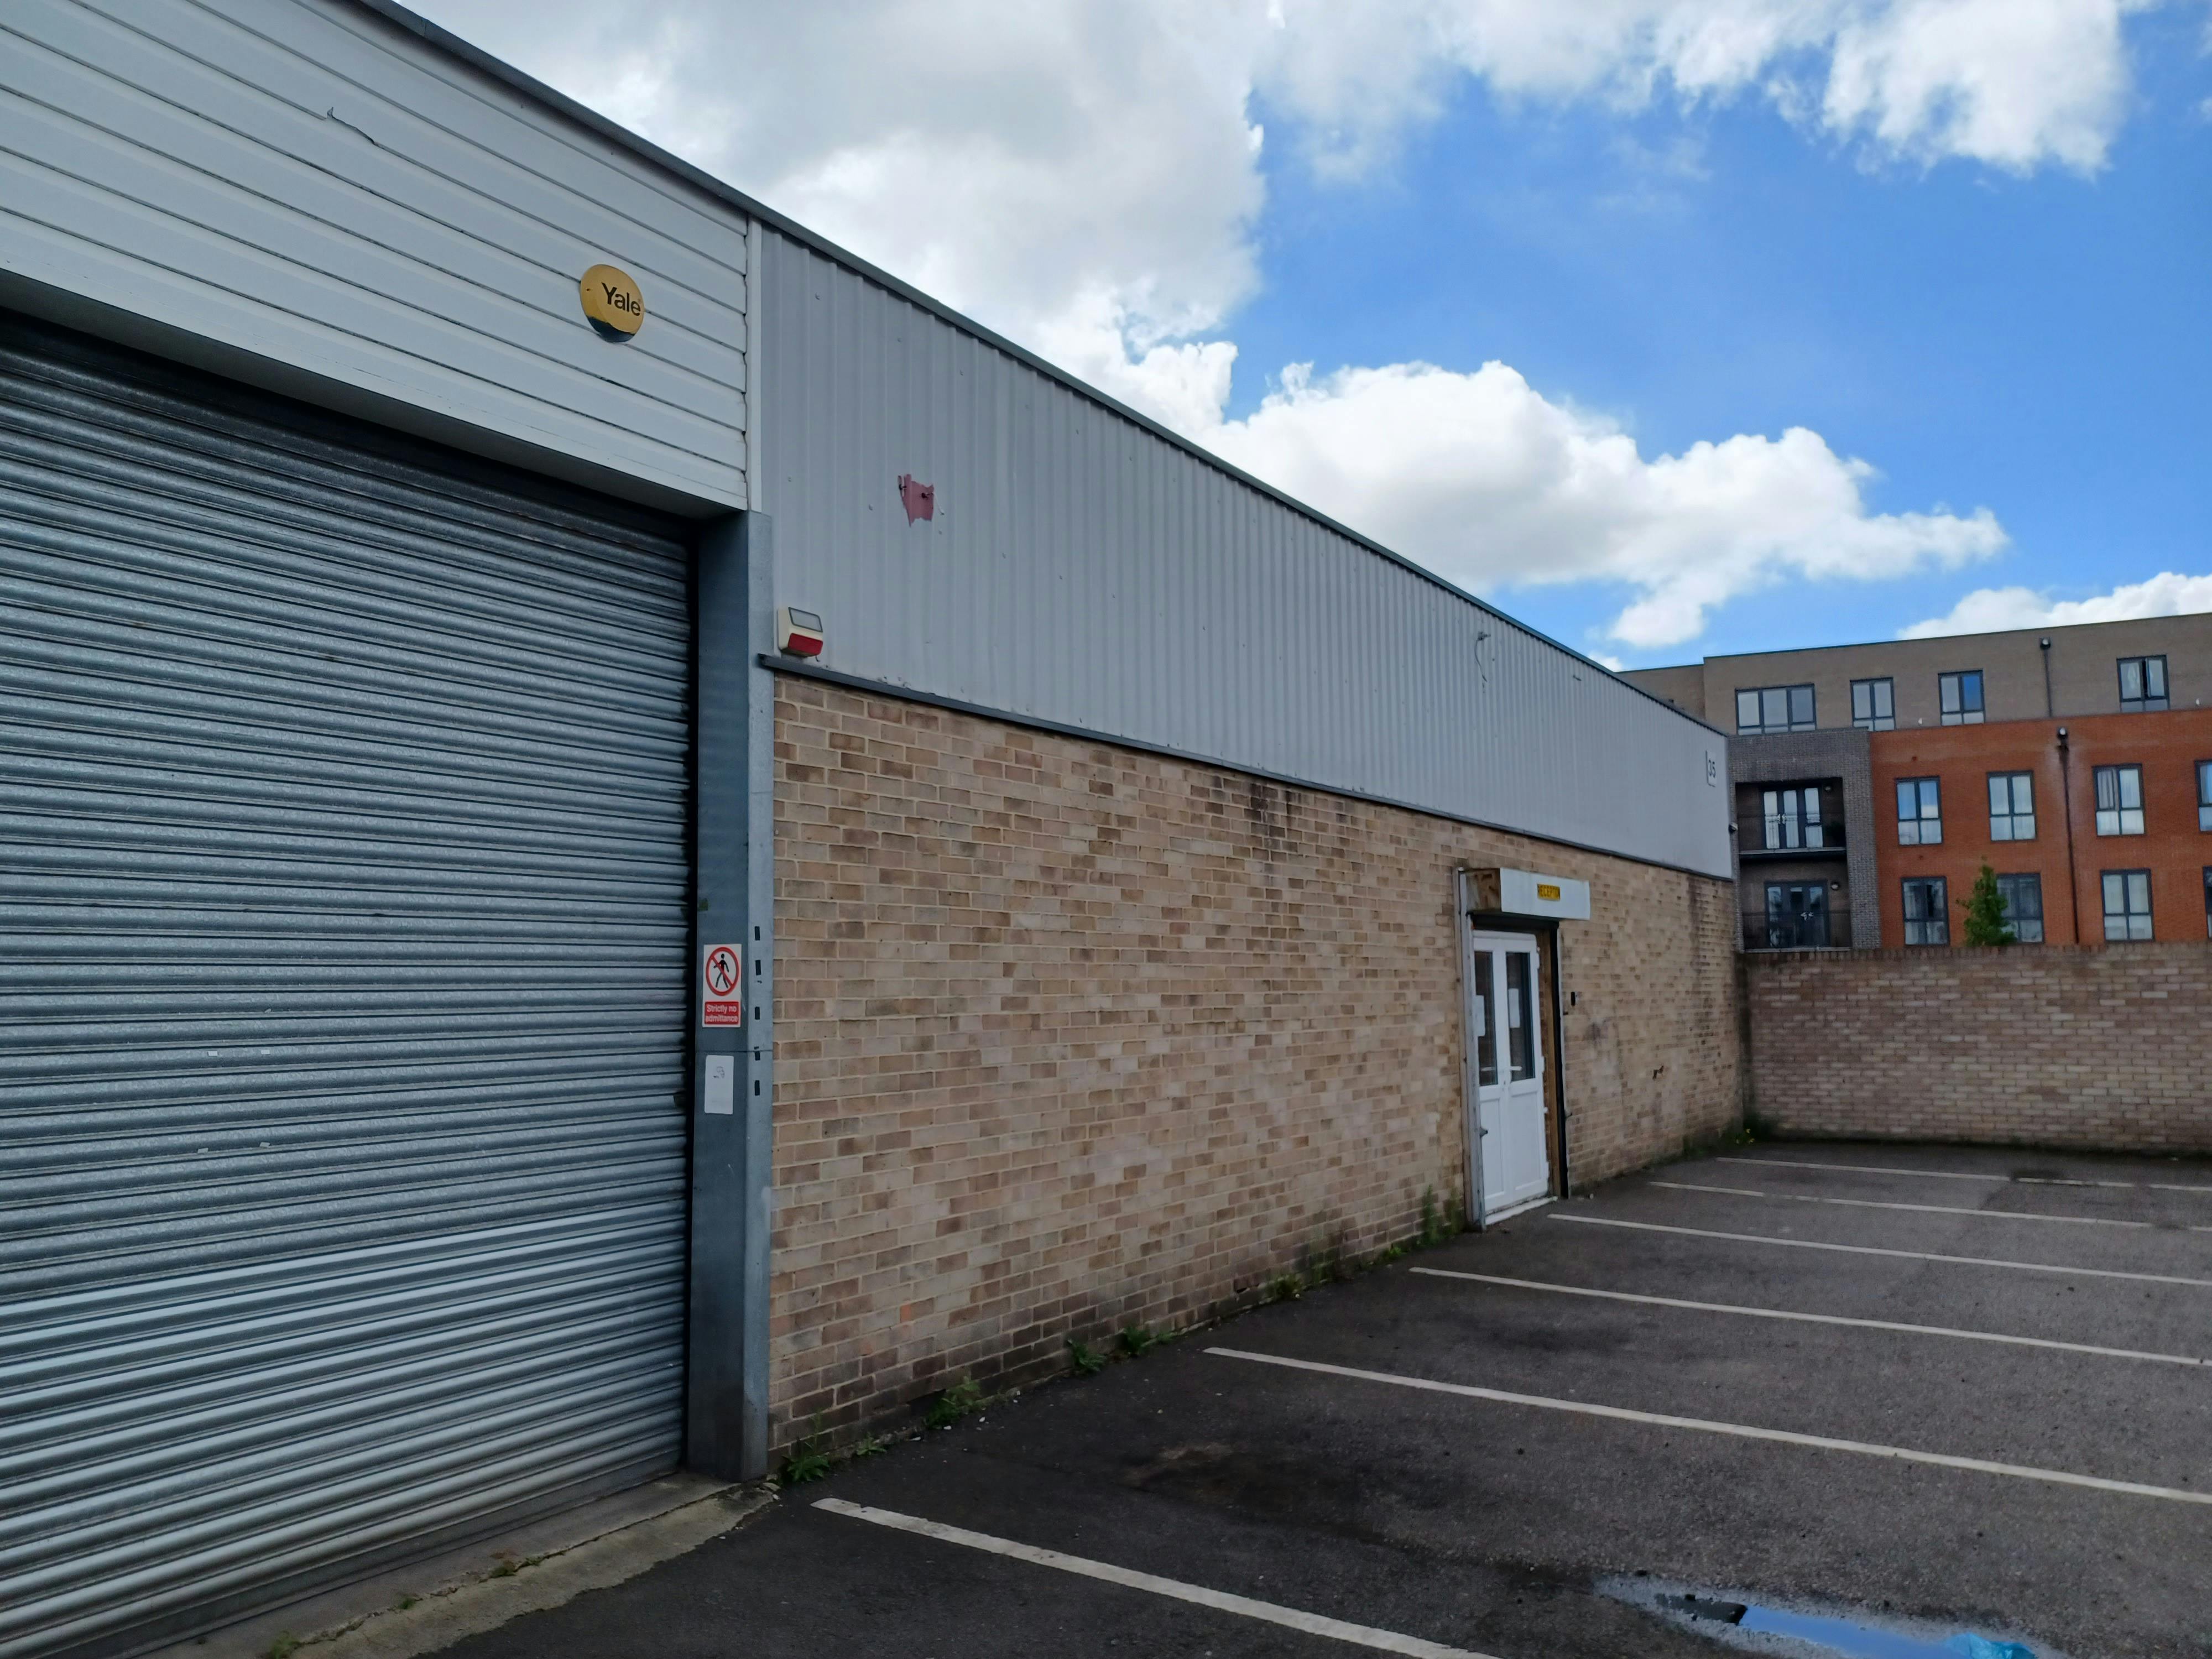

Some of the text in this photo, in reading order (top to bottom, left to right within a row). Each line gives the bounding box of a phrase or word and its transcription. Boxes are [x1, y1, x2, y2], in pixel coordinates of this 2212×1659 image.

[601, 281, 641, 316] Yale
[1708, 759, 1717, 779] 35
[707, 1004, 728, 1014] Strictly
[705, 1014, 738, 1022] admittance
